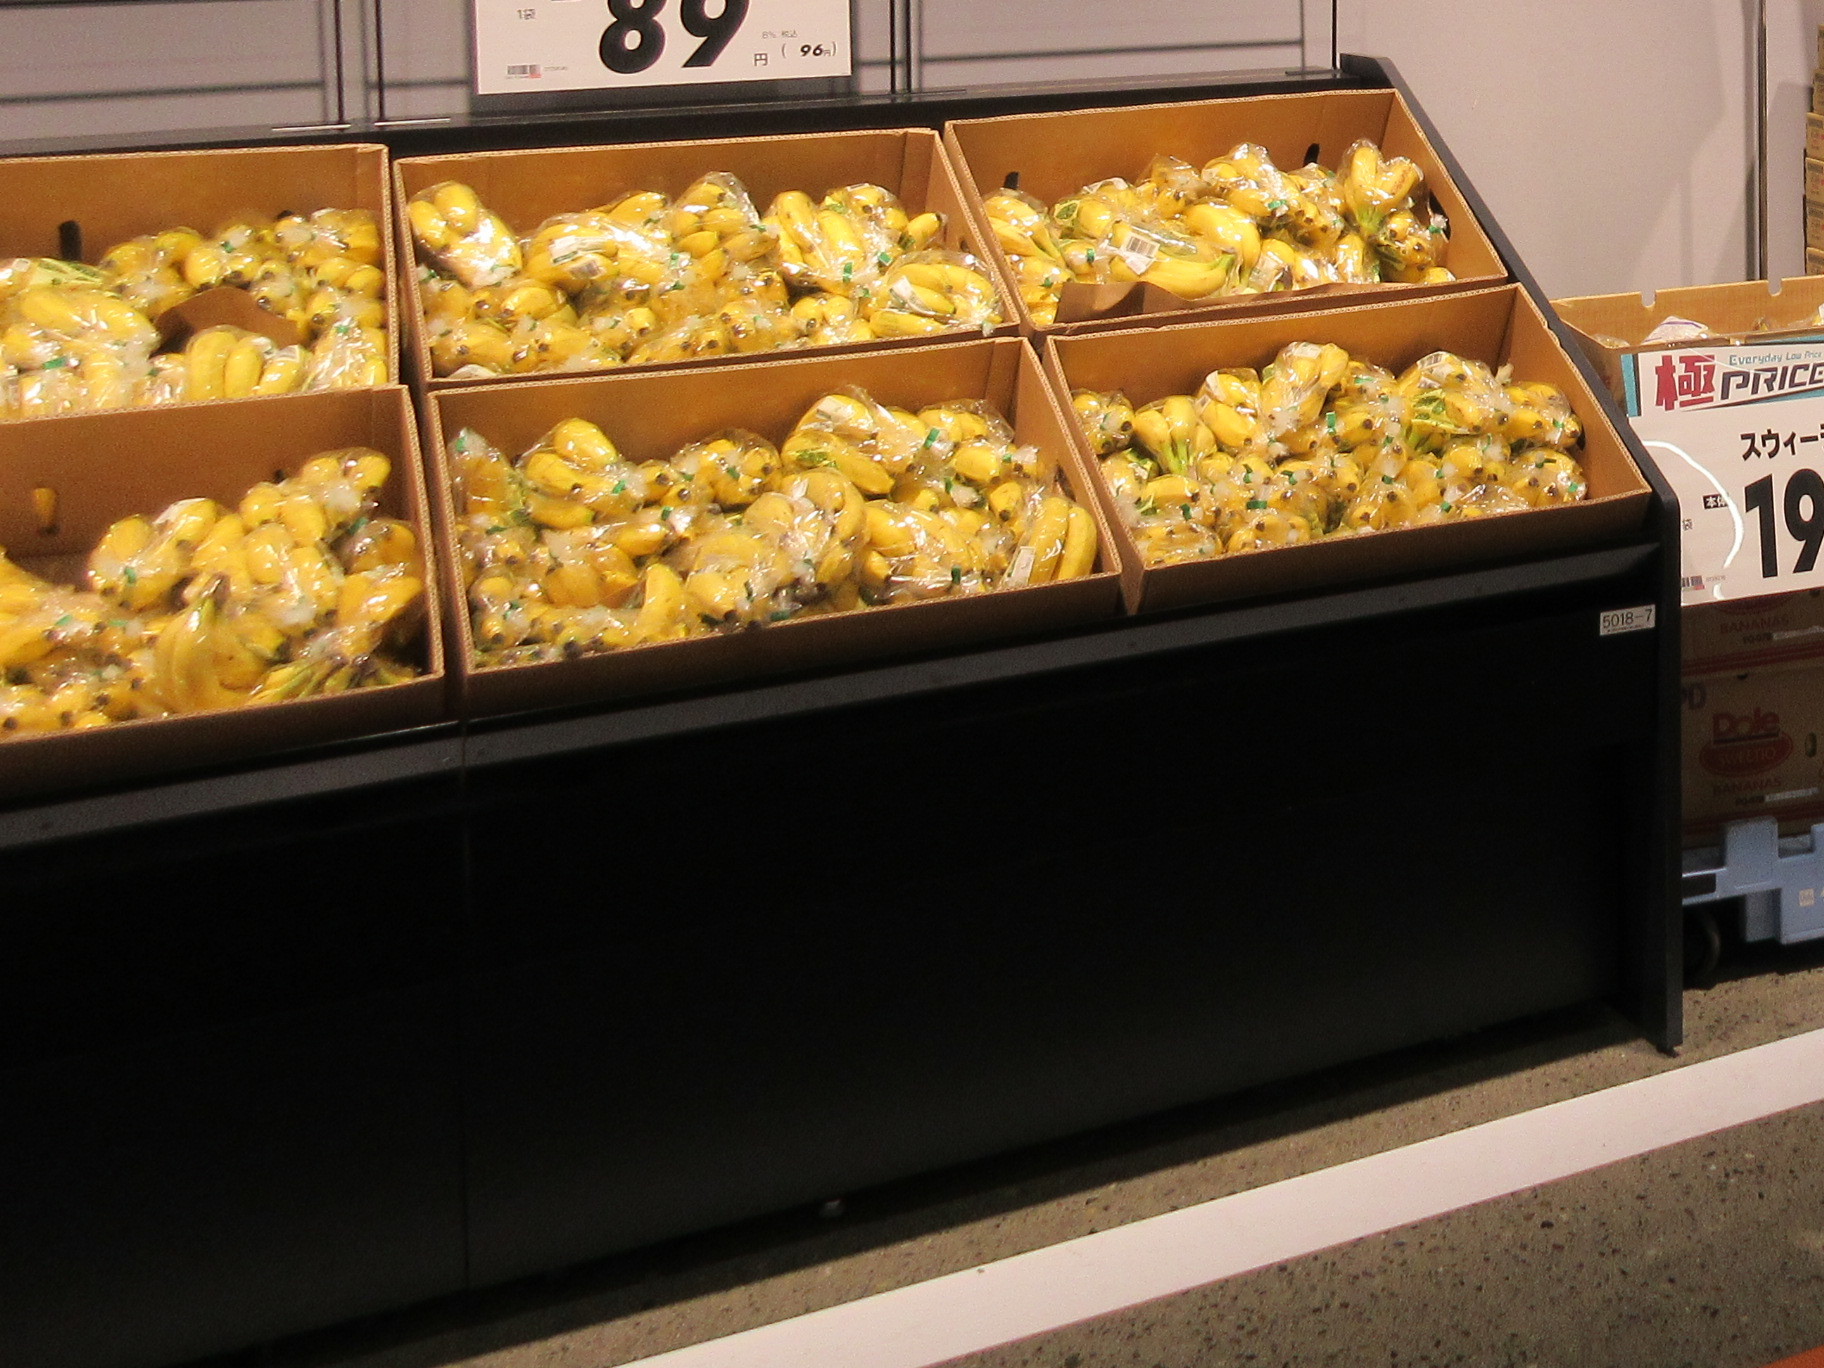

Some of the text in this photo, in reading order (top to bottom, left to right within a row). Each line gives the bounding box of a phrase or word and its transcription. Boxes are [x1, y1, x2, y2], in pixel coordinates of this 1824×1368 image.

[753, 53, 768, 67] 円
[1729, 349, 1823, 367] Everyday Low Price
[1655, 354, 1716, 411] 極
[1602, 608, 1653, 629] 5018-7
